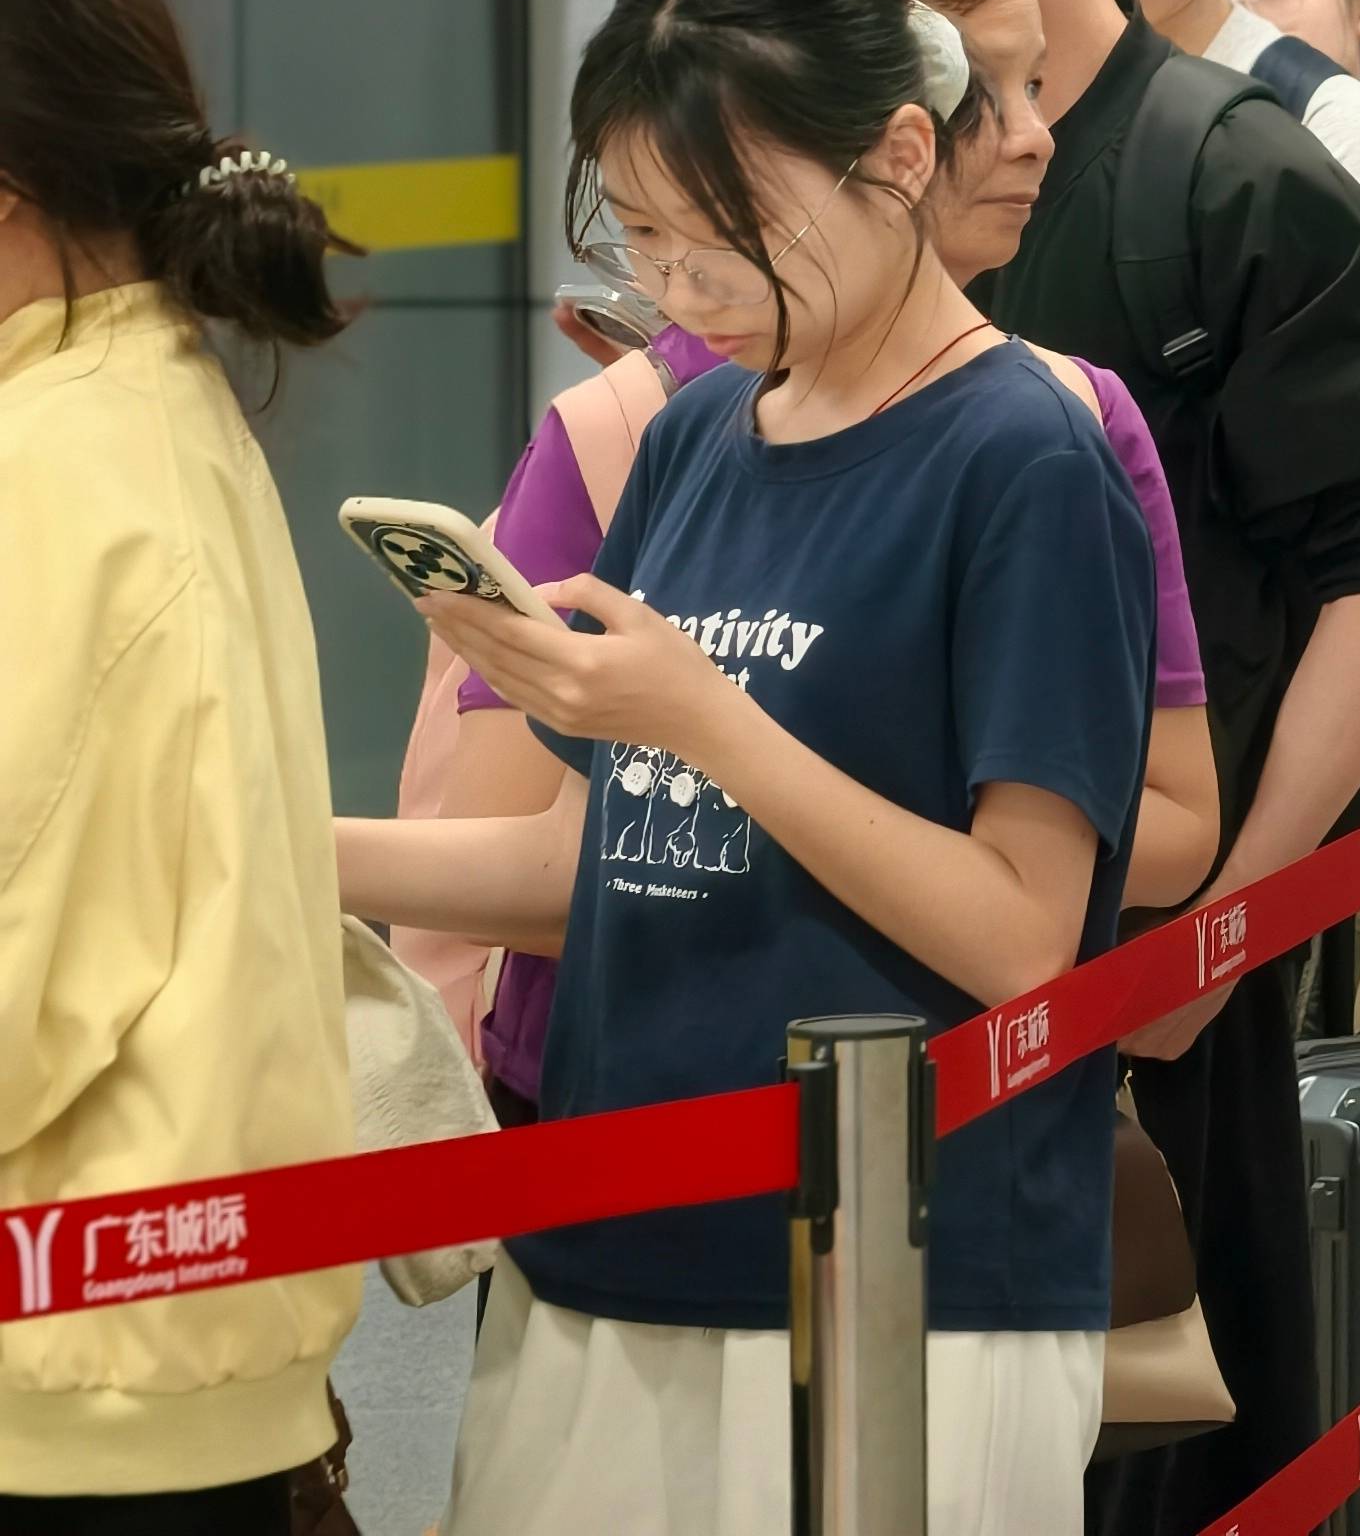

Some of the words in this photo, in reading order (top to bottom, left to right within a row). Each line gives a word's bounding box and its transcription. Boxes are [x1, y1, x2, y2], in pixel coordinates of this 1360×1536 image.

[613, 877, 643, 894] Three
[82, 1193, 248, 1277] 广东城际
